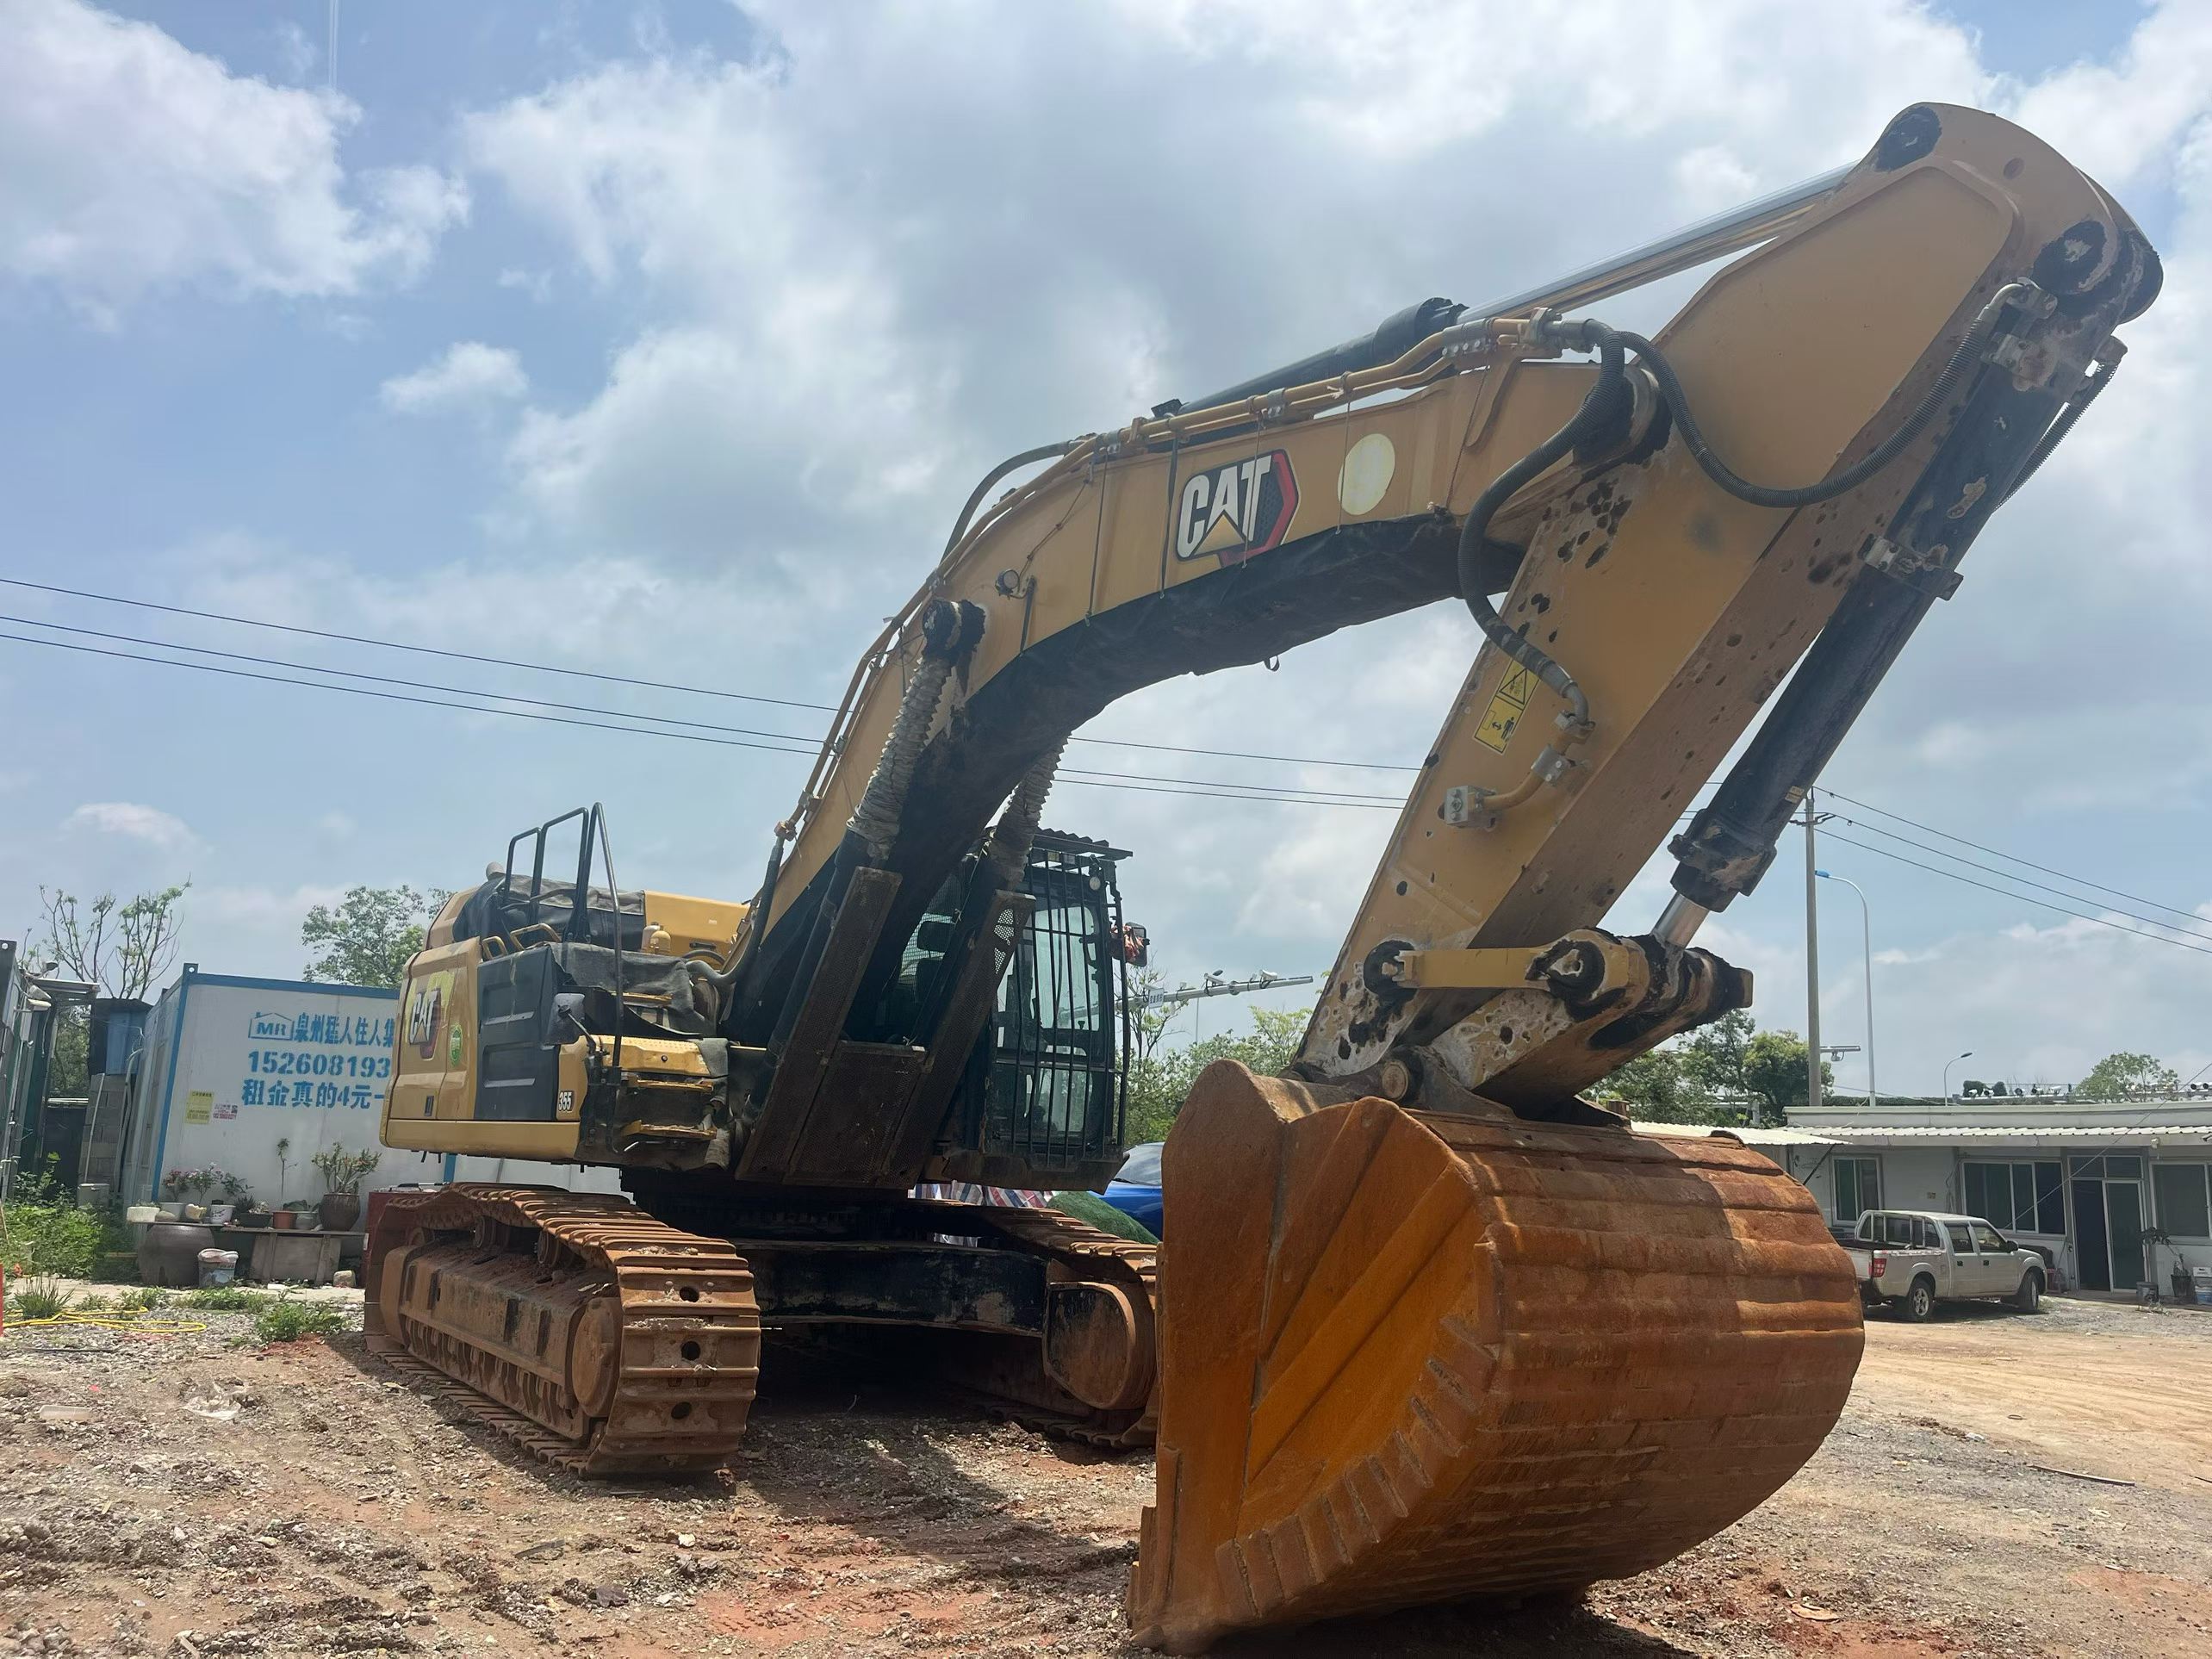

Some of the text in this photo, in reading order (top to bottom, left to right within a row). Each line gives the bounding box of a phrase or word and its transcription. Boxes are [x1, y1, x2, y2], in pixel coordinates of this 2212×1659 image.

[1177, 454, 1272, 558] CAT
[257, 1022, 287, 1037] MR
[410, 990, 438, 1044] CAT
[248, 1051, 391, 1078] 152608193
[558, 1091, 573, 1111] 355
